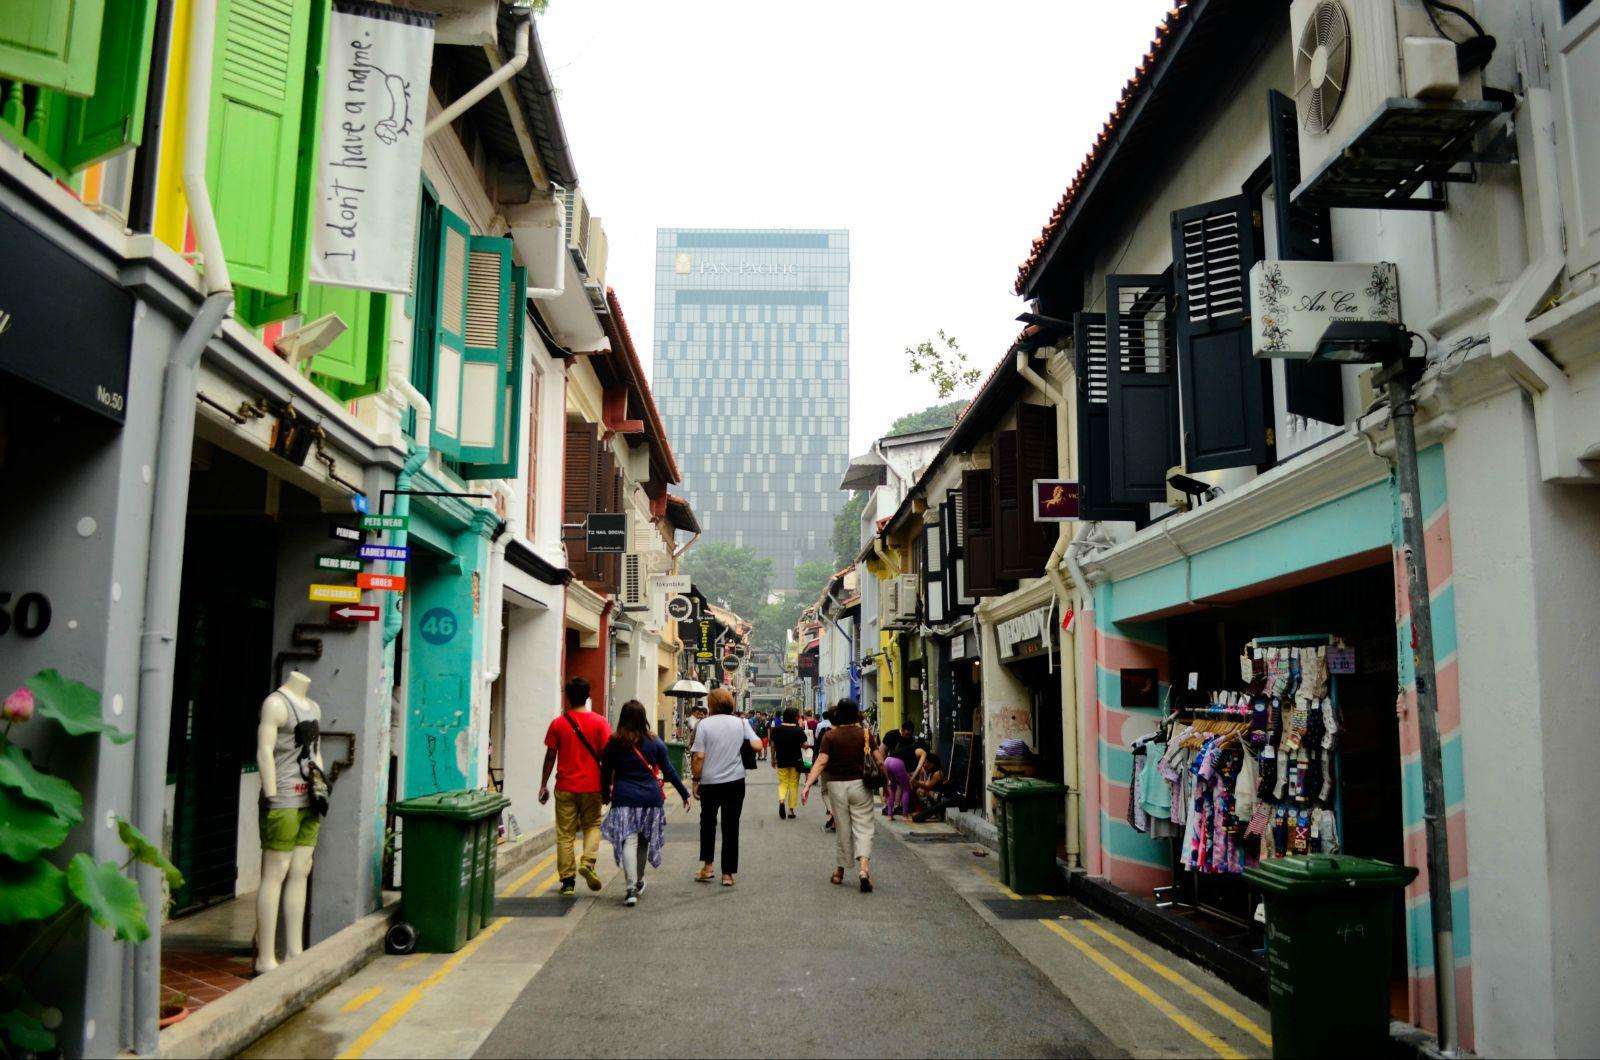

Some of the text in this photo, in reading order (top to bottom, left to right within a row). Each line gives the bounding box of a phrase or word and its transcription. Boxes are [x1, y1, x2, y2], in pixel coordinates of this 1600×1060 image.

[345, 101, 366, 113] a
[329, 120, 367, 170] have
[326, 178, 365, 239] don't
[325, 249, 356, 262] I
[700, 259, 798, 276] PAN PACIFIC
[97, 384, 123, 411] No.50
[364, 518, 403, 527] PETS WEAR
[361, 547, 406, 559] LADIES WEAR
[340, 559, 360, 571] WEAR
[0, 591, 52, 638] 0
[423, 616, 454, 635] 46
